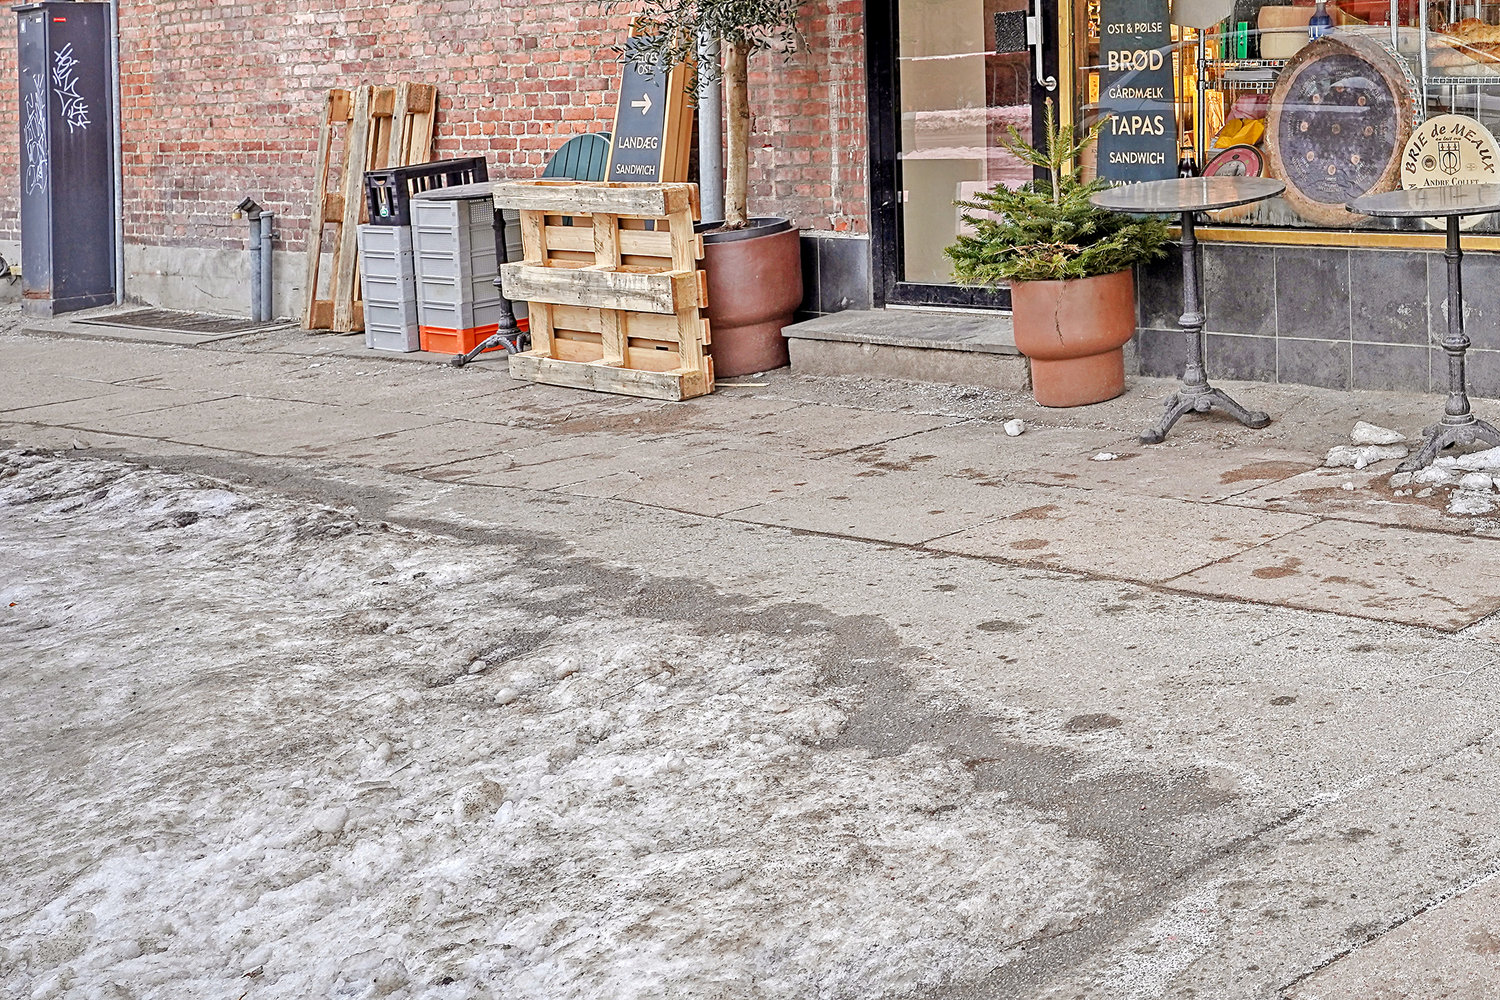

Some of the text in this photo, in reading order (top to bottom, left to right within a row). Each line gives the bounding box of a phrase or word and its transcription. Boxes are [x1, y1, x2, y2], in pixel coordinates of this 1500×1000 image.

[1107, 22, 1163, 34] OST & PØLSE
[1108, 49, 1164, 72] BRØD
[1109, 85, 1164, 99] GÅRDMÆLK
[1110, 115, 1165, 136] TAPAS
[618, 136, 658, 149] LANDÆG
[1405, 123, 1495, 175] BRIE de MEAUX
[1109, 152, 1165, 164] SANDWICH
[616, 163, 656, 175] SANDWICH
